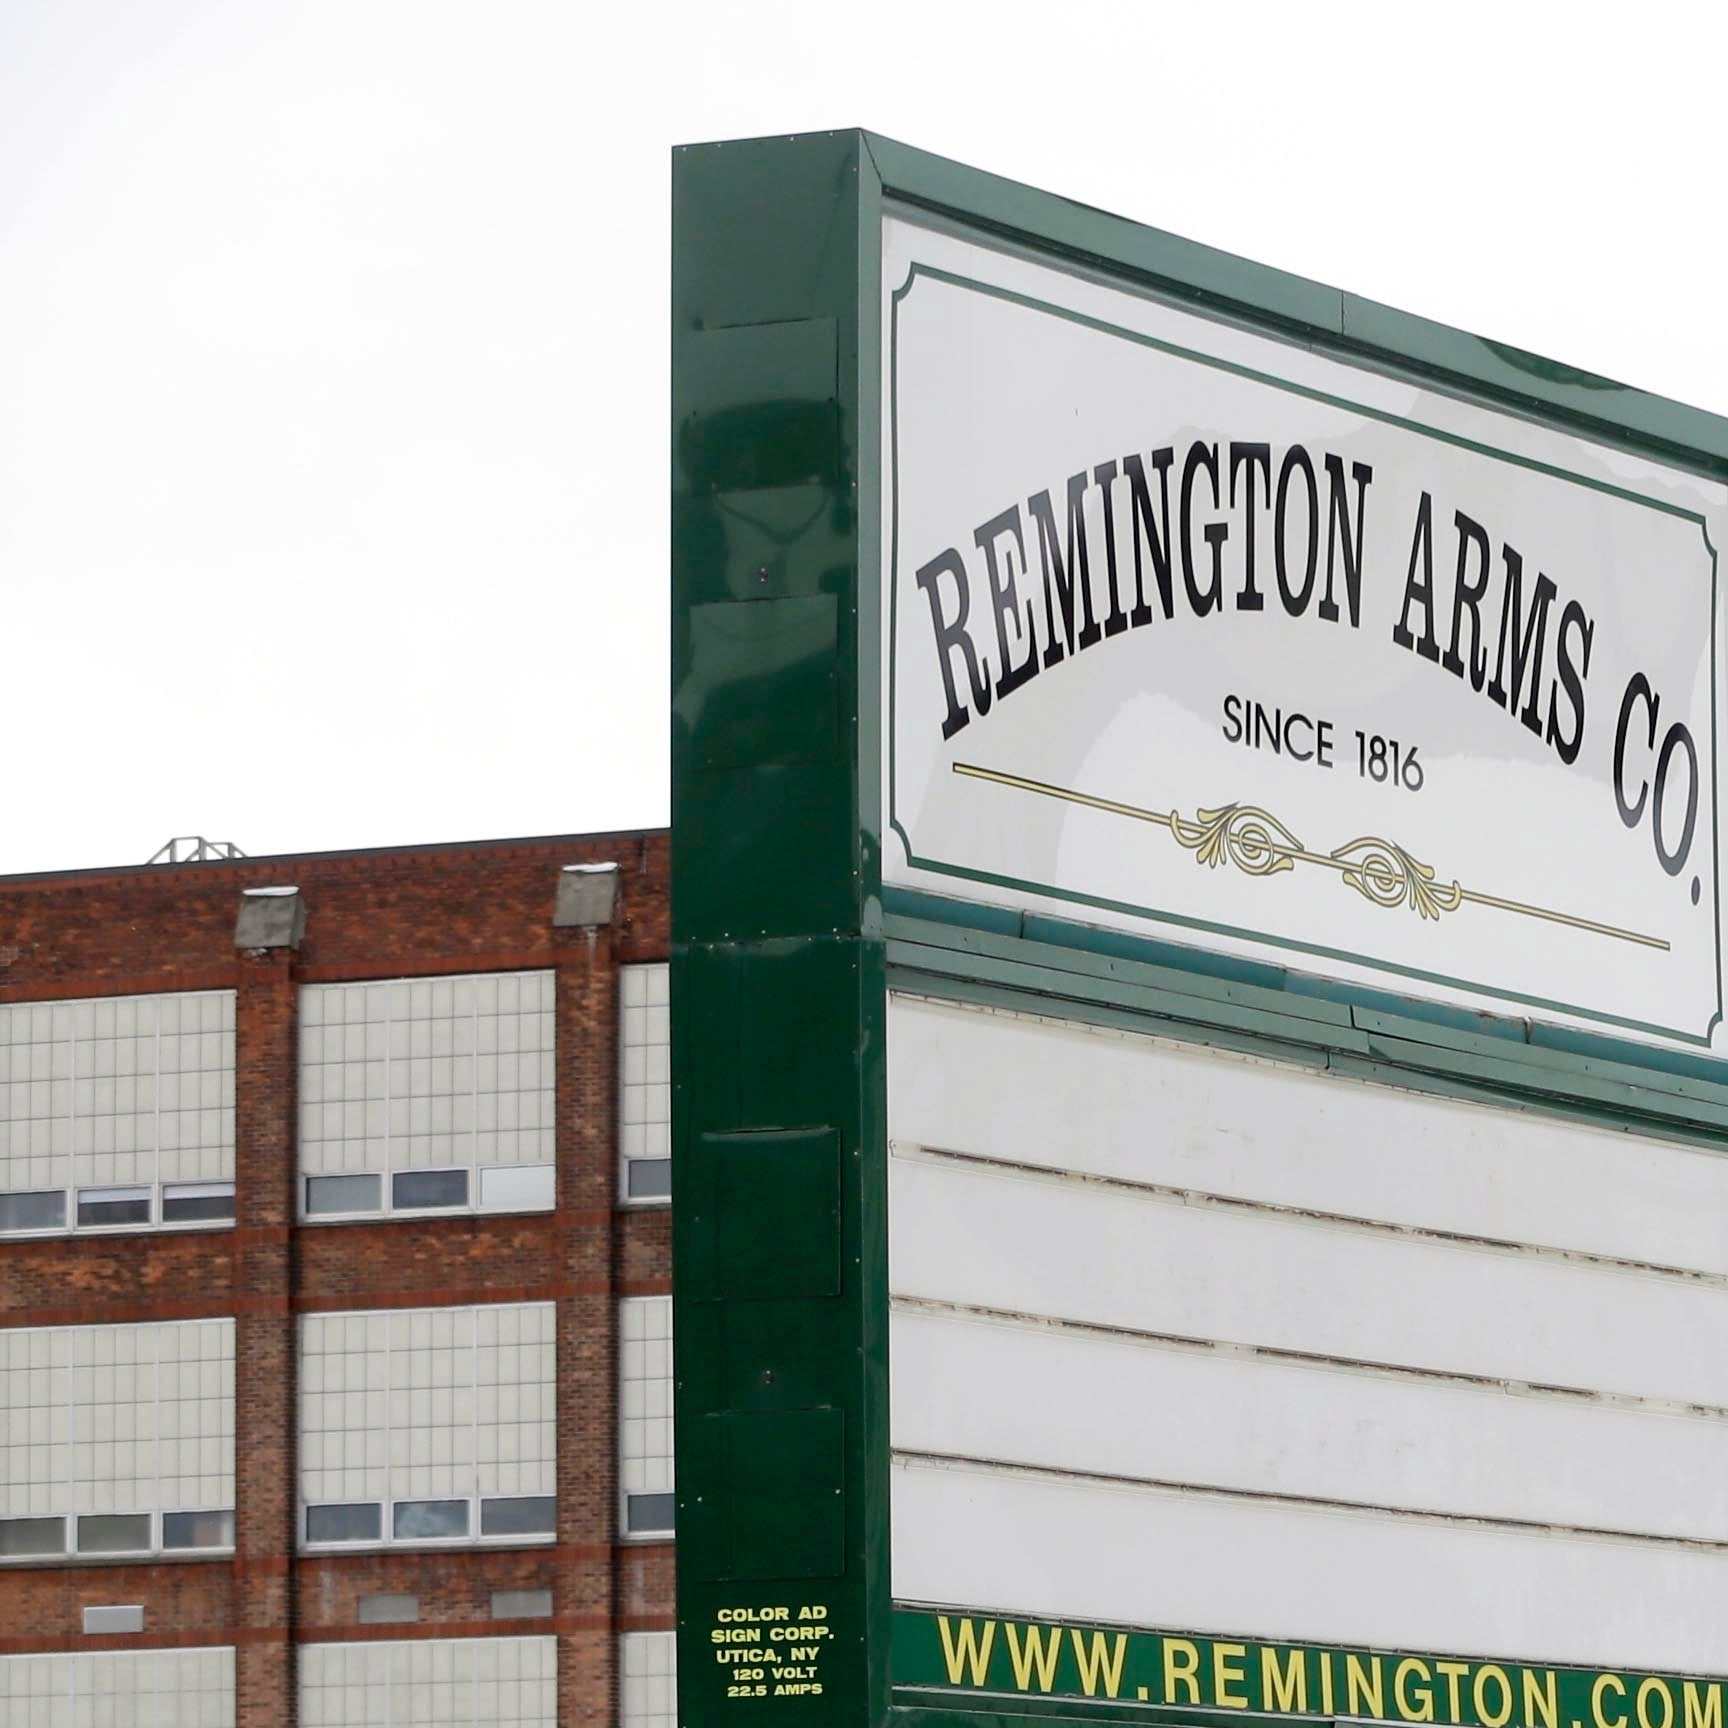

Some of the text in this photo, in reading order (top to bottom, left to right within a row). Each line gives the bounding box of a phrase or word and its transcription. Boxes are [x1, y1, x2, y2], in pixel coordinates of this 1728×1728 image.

[915, 440, 1701, 906] REMINGTON ARMS CO.
[1223, 694, 1424, 791] SINCE 1816
[717, 1605, 828, 1623] COLOR AD
[710, 1625, 835, 1644] SIGN CORP.
[716, 1646, 820, 1664] UTICA, NY
[732, 1666, 818, 1681] 120 VOLT
[727, 1683, 823, 1698] 22.5 AMPS
